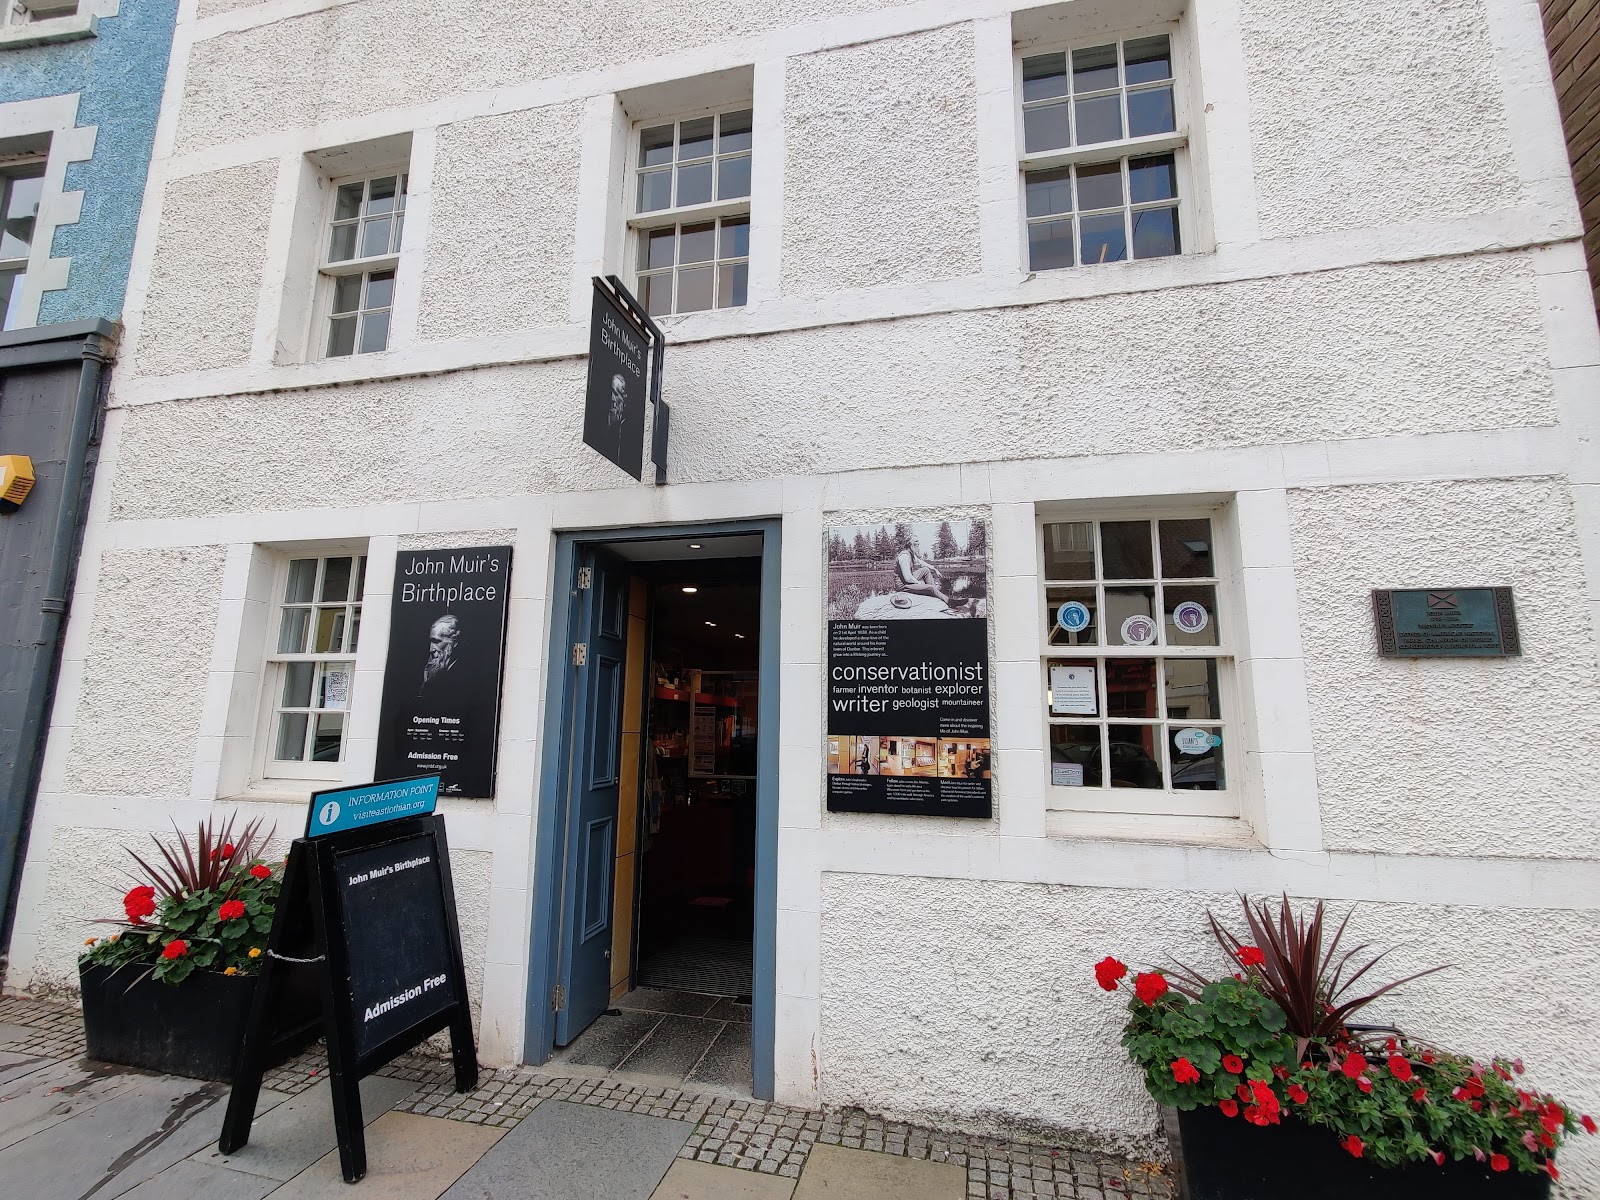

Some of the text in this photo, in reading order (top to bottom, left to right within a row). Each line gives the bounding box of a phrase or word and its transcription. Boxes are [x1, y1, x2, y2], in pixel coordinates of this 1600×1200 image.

[603, 312, 642, 359] John Muir's
[601, 328, 640, 377] Birthplace
[405, 554, 499, 575] John Muir's
[402, 582, 496, 607] Birthplace
[832, 662, 983, 680] conservationist
[858, 684, 898, 694] inventor
[902, 686, 932, 694] botanist
[935, 682, 983, 697] explorer
[832, 695, 889, 712] writer
[893, 698, 939, 711] geologist
[413, 716, 439, 724] Opening
[348, 788, 408, 807] INFORMATION
[410, 784, 434, 796] POINT
[353, 800, 425, 820] visiteastlothian.org
[348, 856, 430, 886] John Muir's Birthplace
[364, 974, 447, 1023] Admission Free
